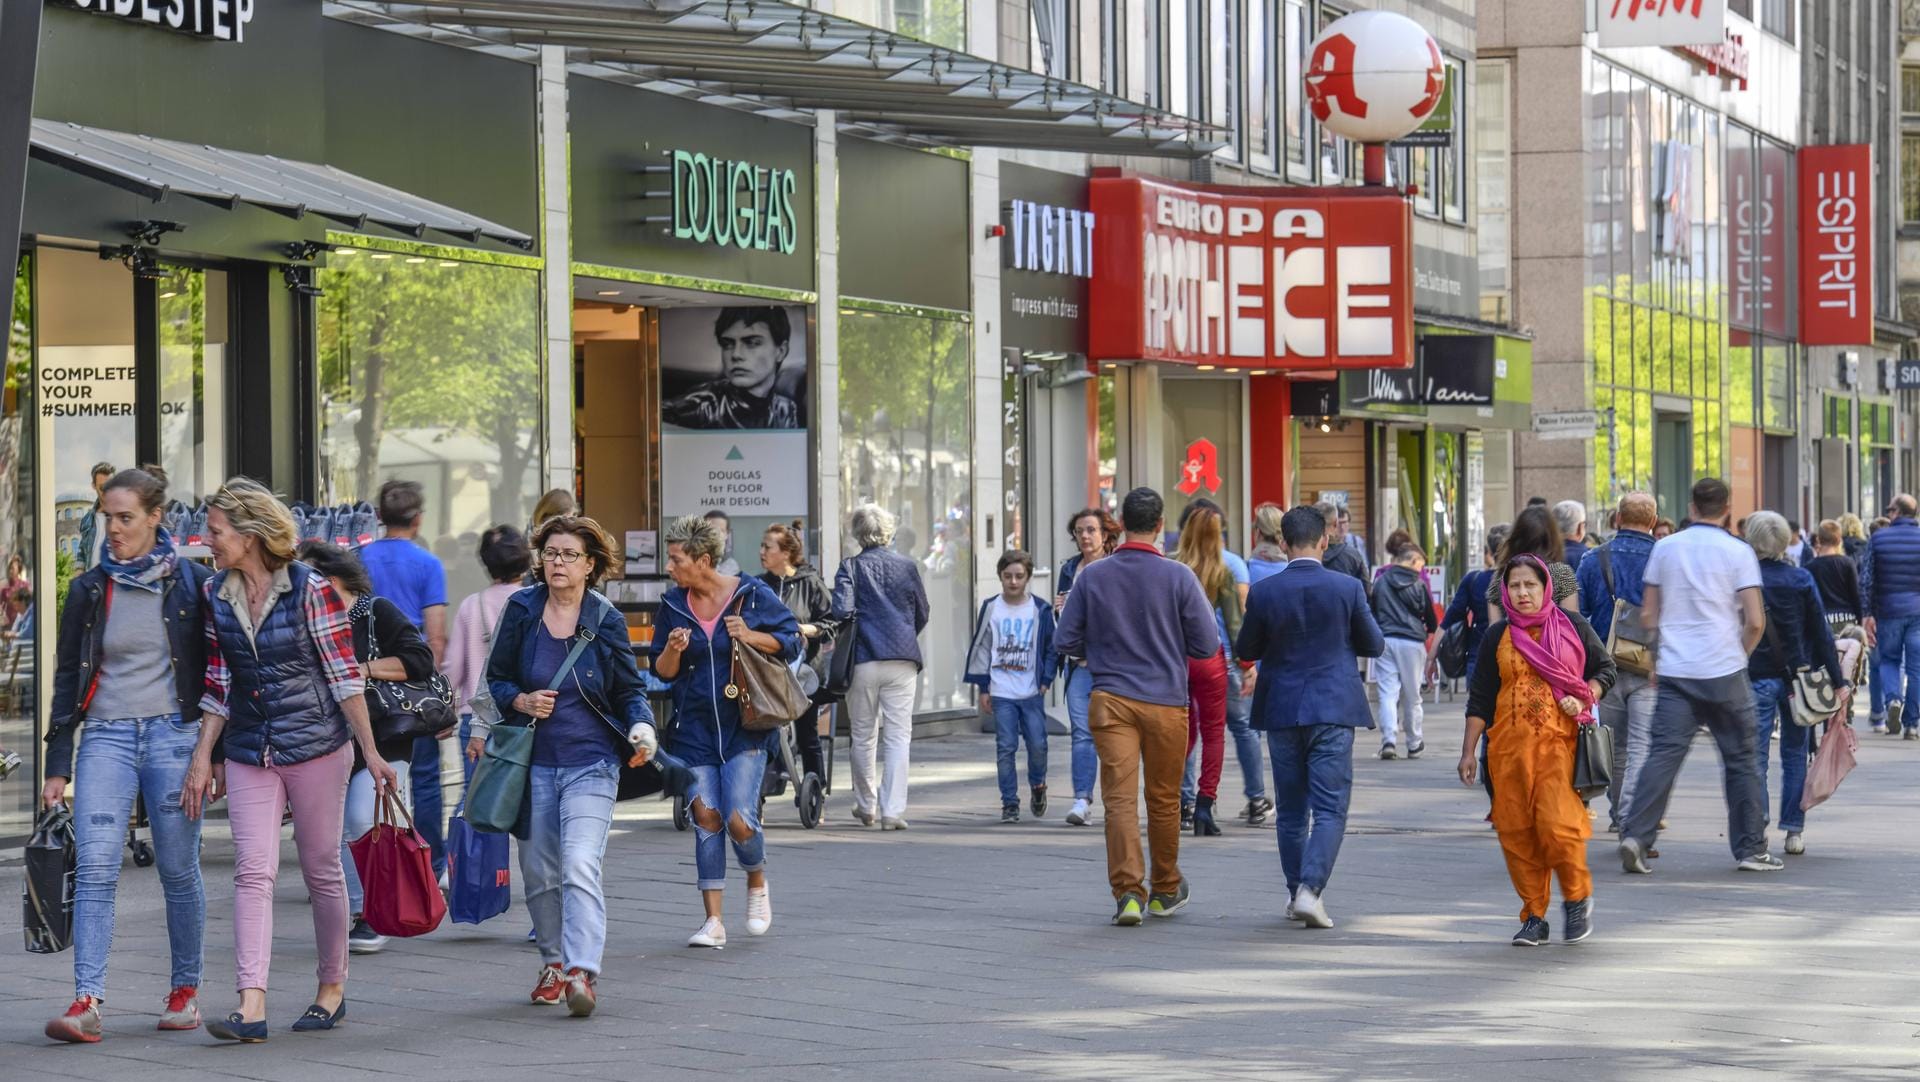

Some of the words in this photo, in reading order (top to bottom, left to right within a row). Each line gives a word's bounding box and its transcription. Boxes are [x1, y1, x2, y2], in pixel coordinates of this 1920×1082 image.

[74, 0, 255, 43] STEP
[674, 150, 797, 255] DOUGLAS
[1157, 194, 1325, 239] EUROPA
[1011, 199, 1095, 278] VAGANT
[1817, 171, 1856, 318] ESPRIT
[1011, 291, 1041, 318] impress
[1042, 295, 1059, 316] with
[1060, 296, 1079, 319] dress
[1144, 232, 1393, 356] APOTHEKE
[42, 367, 136, 381] COMPLETE
[42, 385, 93, 399] YOUR
[42, 402, 185, 416] #SUMMEROK
[708, 470, 761, 480] DOUGLAS
[726, 483, 763, 493] FLOOR
[700, 497, 726, 507] HAIR
[729, 496, 770, 507] DESIGN
